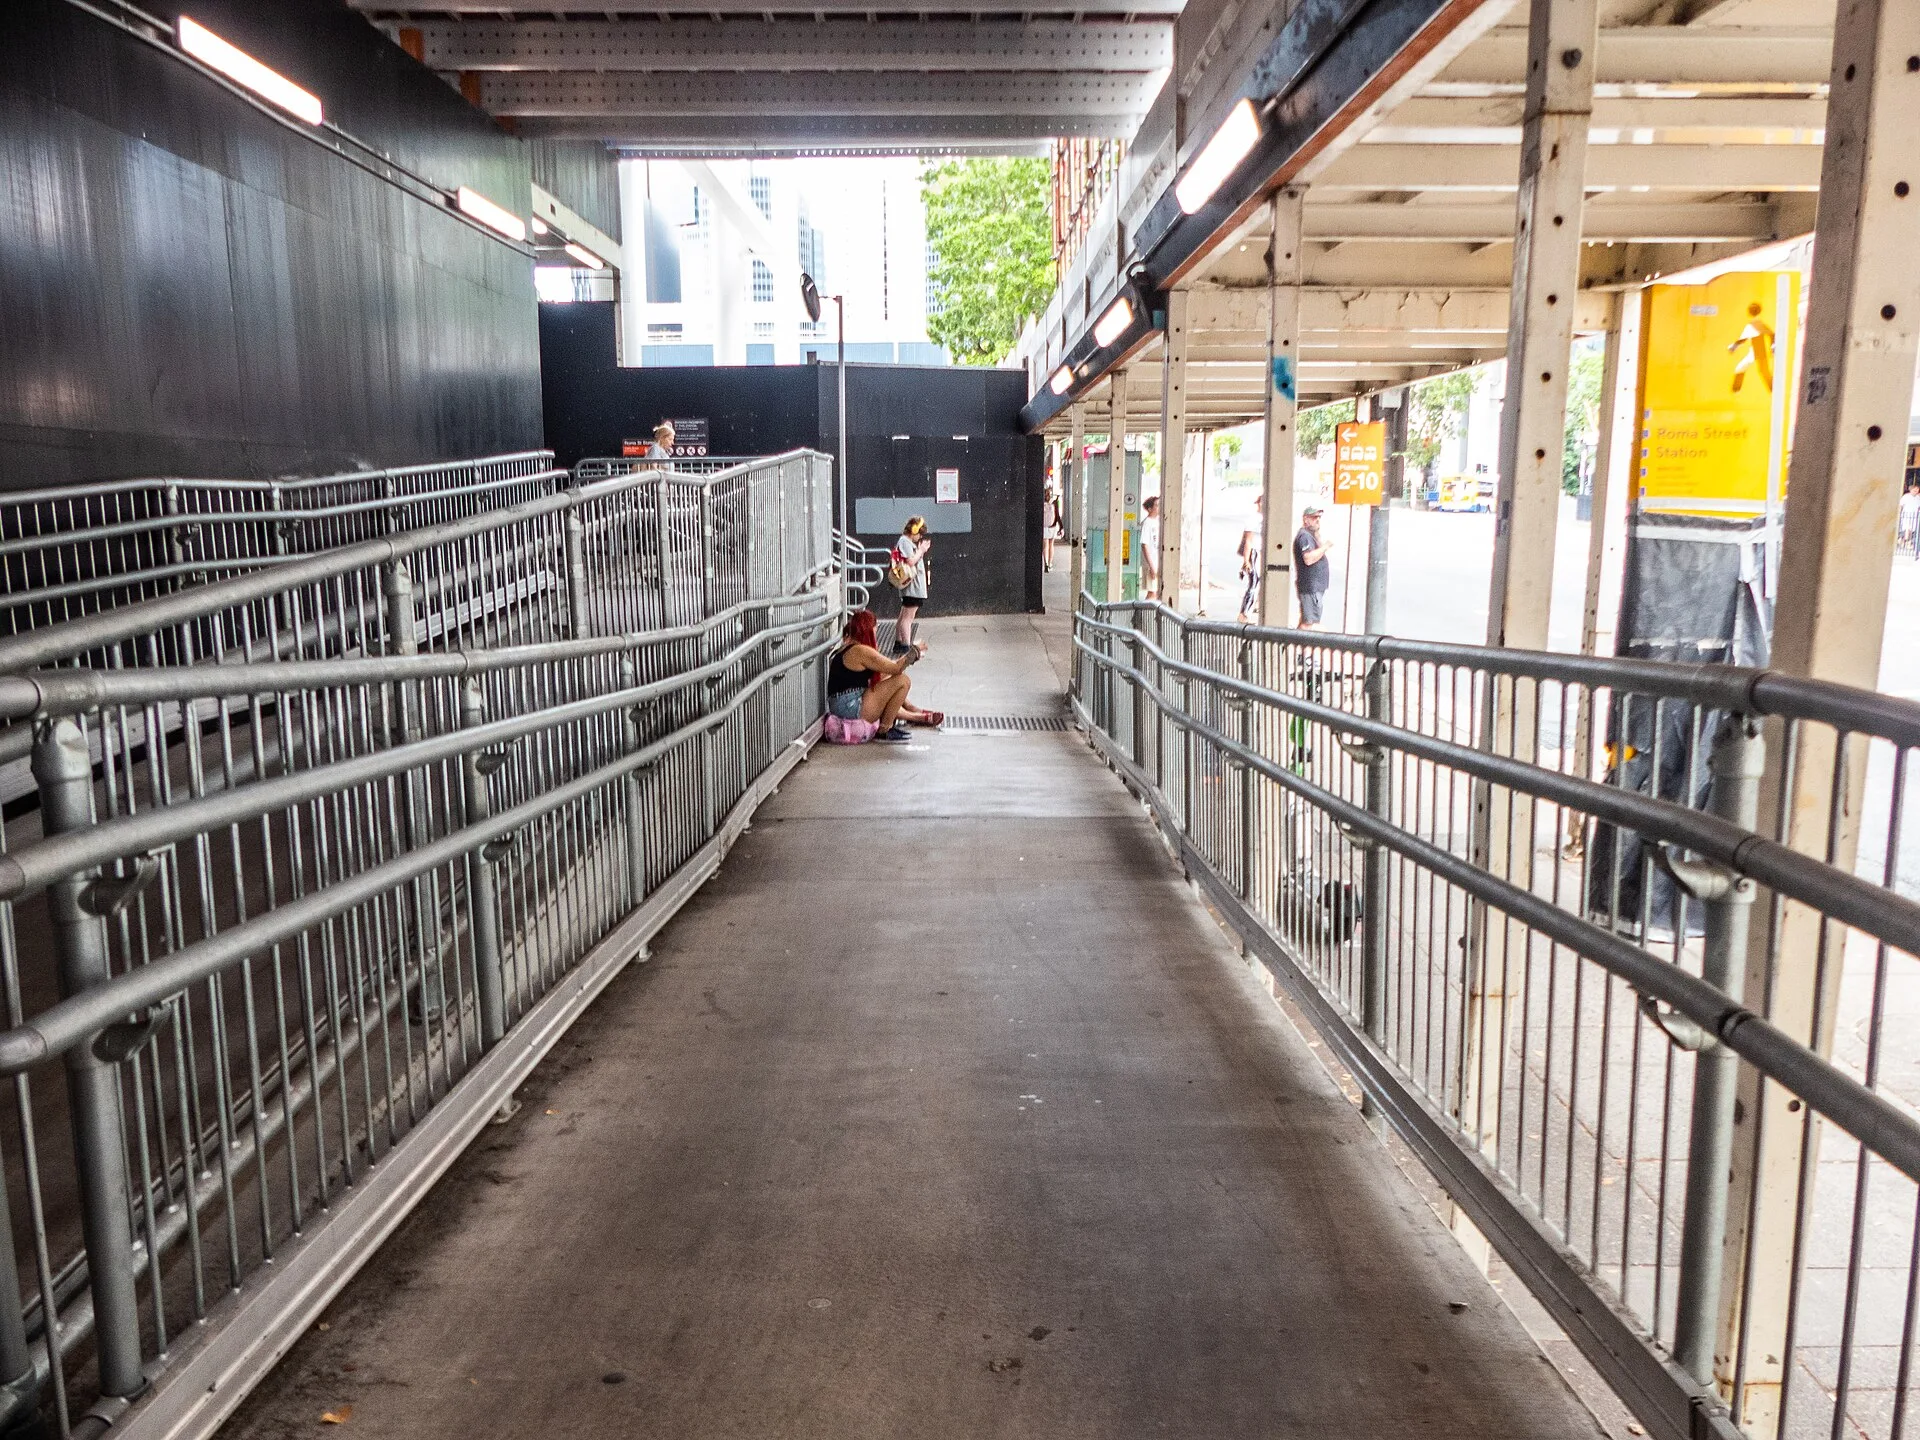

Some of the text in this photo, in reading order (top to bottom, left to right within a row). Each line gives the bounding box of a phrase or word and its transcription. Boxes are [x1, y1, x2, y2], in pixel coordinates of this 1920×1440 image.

[1657, 427, 1747, 440] Roma Street
[1656, 446, 1708, 458] Station
[1338, 472, 1379, 490] 2-10
